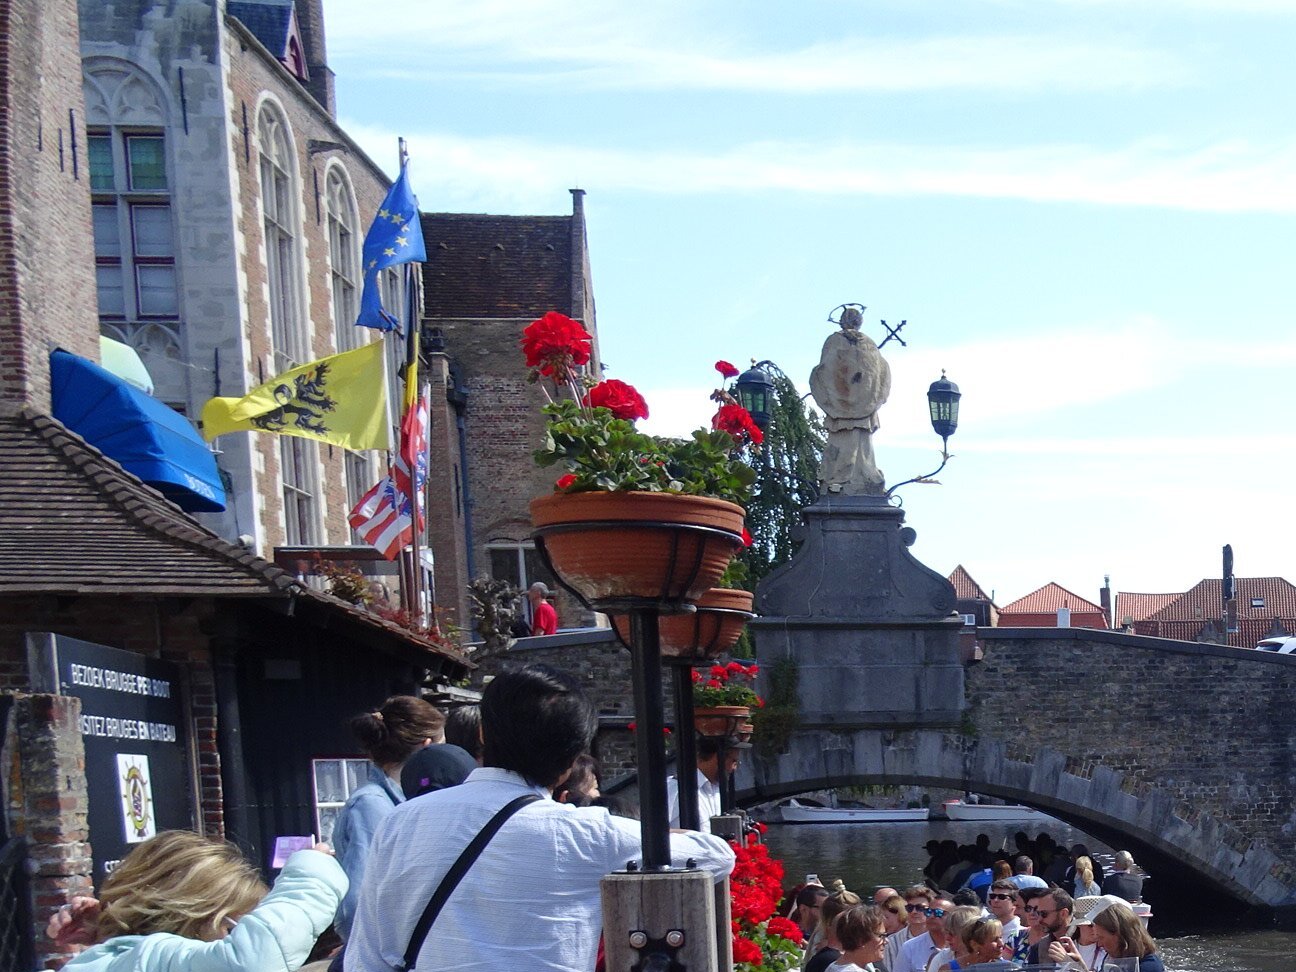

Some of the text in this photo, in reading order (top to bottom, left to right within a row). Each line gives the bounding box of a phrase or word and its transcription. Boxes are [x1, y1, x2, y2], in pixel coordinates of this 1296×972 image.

[71, 663, 170, 699] BEZOEK BRUGGE PER BOOT
[79, 714, 176, 742] ISITEZ BRUGES EN BATEAU
